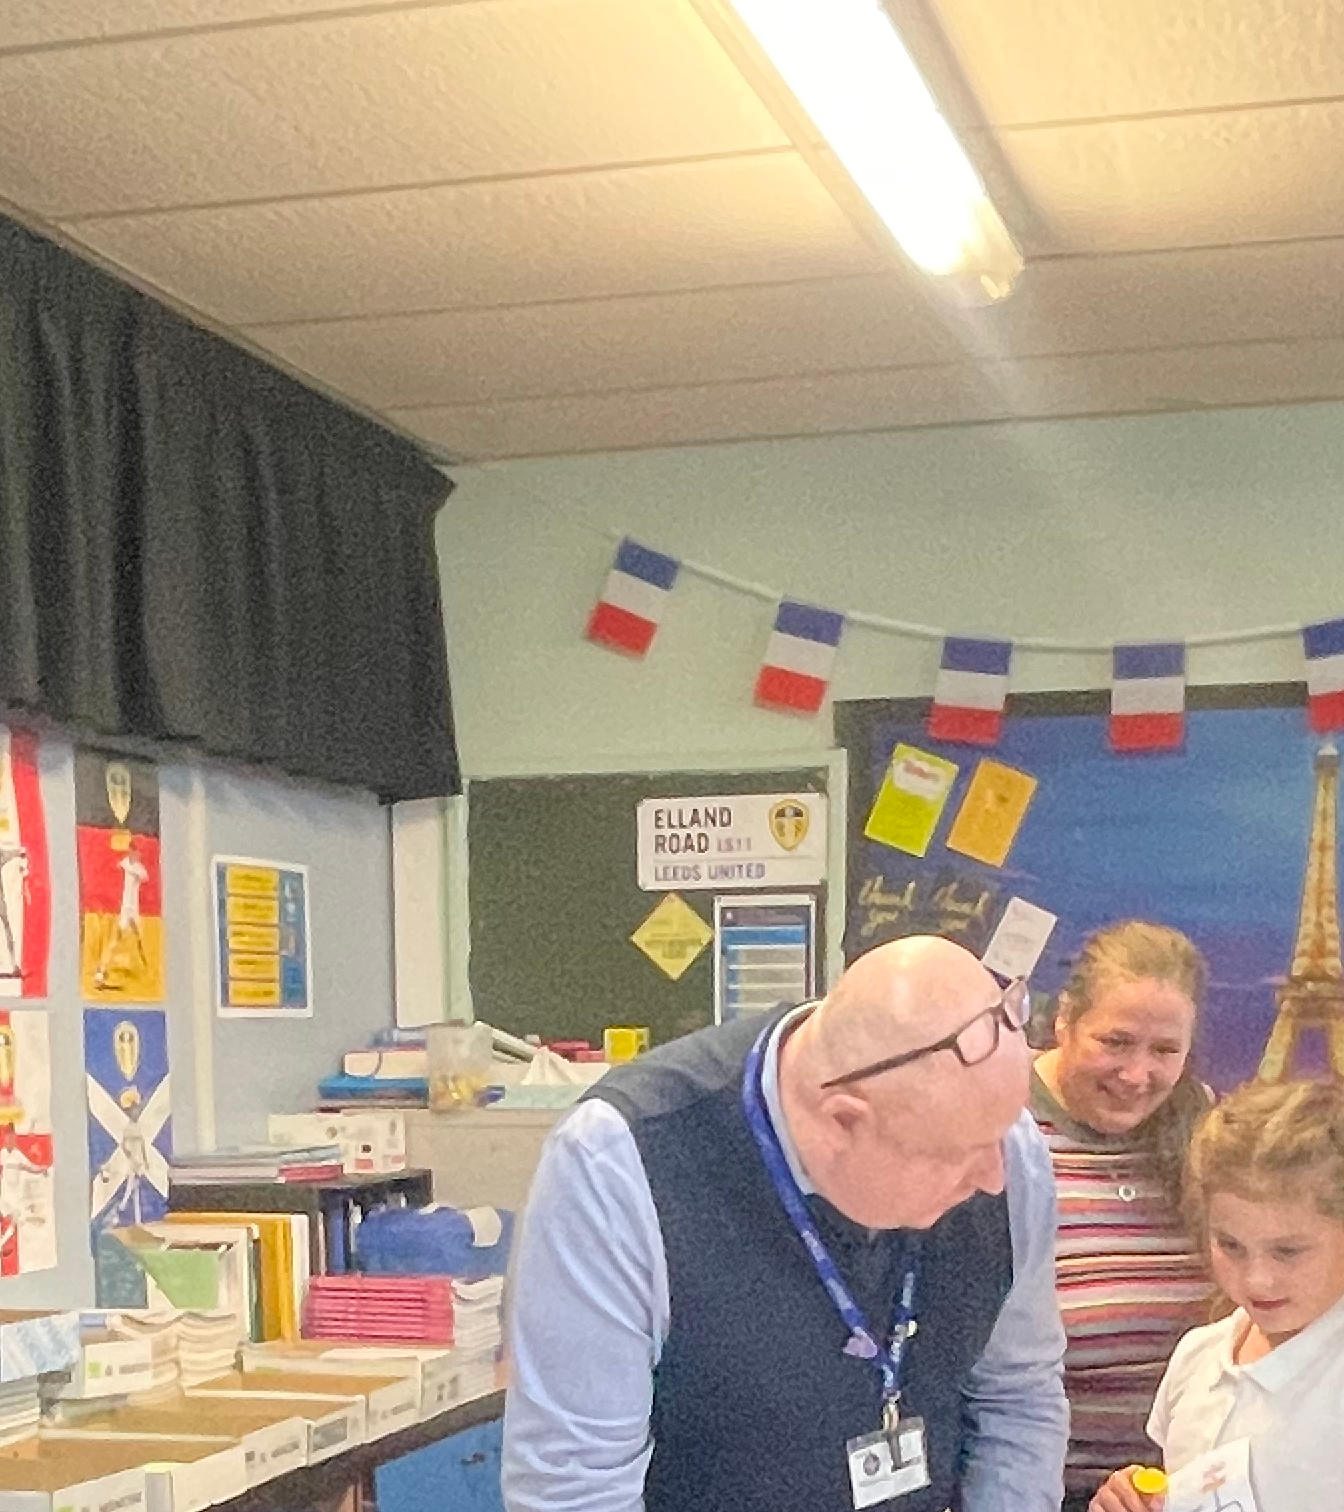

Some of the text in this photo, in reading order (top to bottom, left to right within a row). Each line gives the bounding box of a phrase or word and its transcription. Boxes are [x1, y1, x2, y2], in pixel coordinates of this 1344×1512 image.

[654, 806, 733, 830] ELLAND
[654, 832, 710, 854] ROAD
[654, 862, 766, 883] LEEDS UNITED
